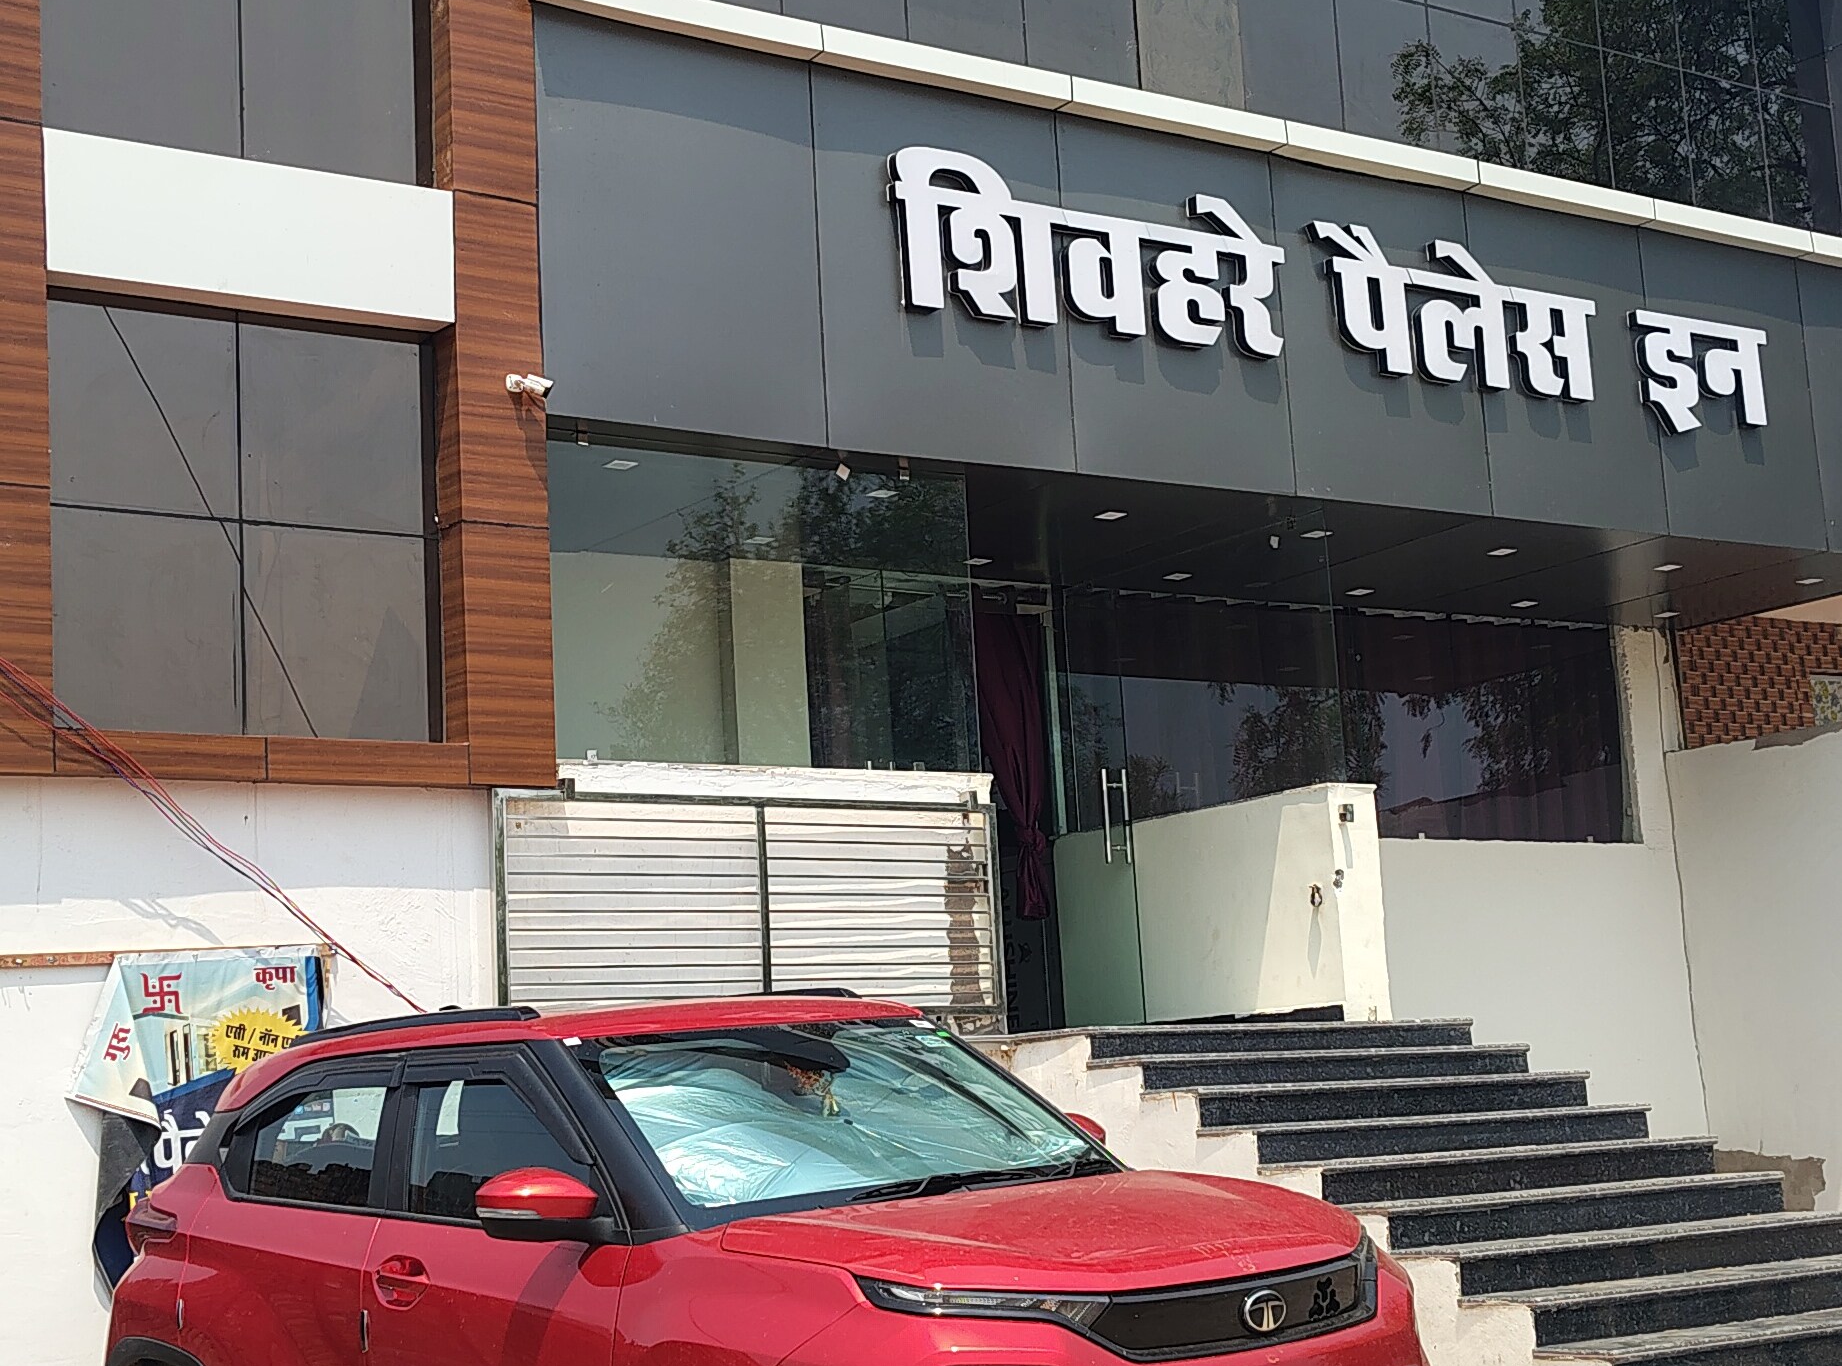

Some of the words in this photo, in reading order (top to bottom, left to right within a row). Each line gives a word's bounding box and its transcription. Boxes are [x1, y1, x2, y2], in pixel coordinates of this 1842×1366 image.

[886, 146, 1285, 360] शिवहरे
[1305, 220, 1596, 403] पैलेस
[1626, 309, 1767, 435] इन
[253, 966, 297, 990] कृपा
